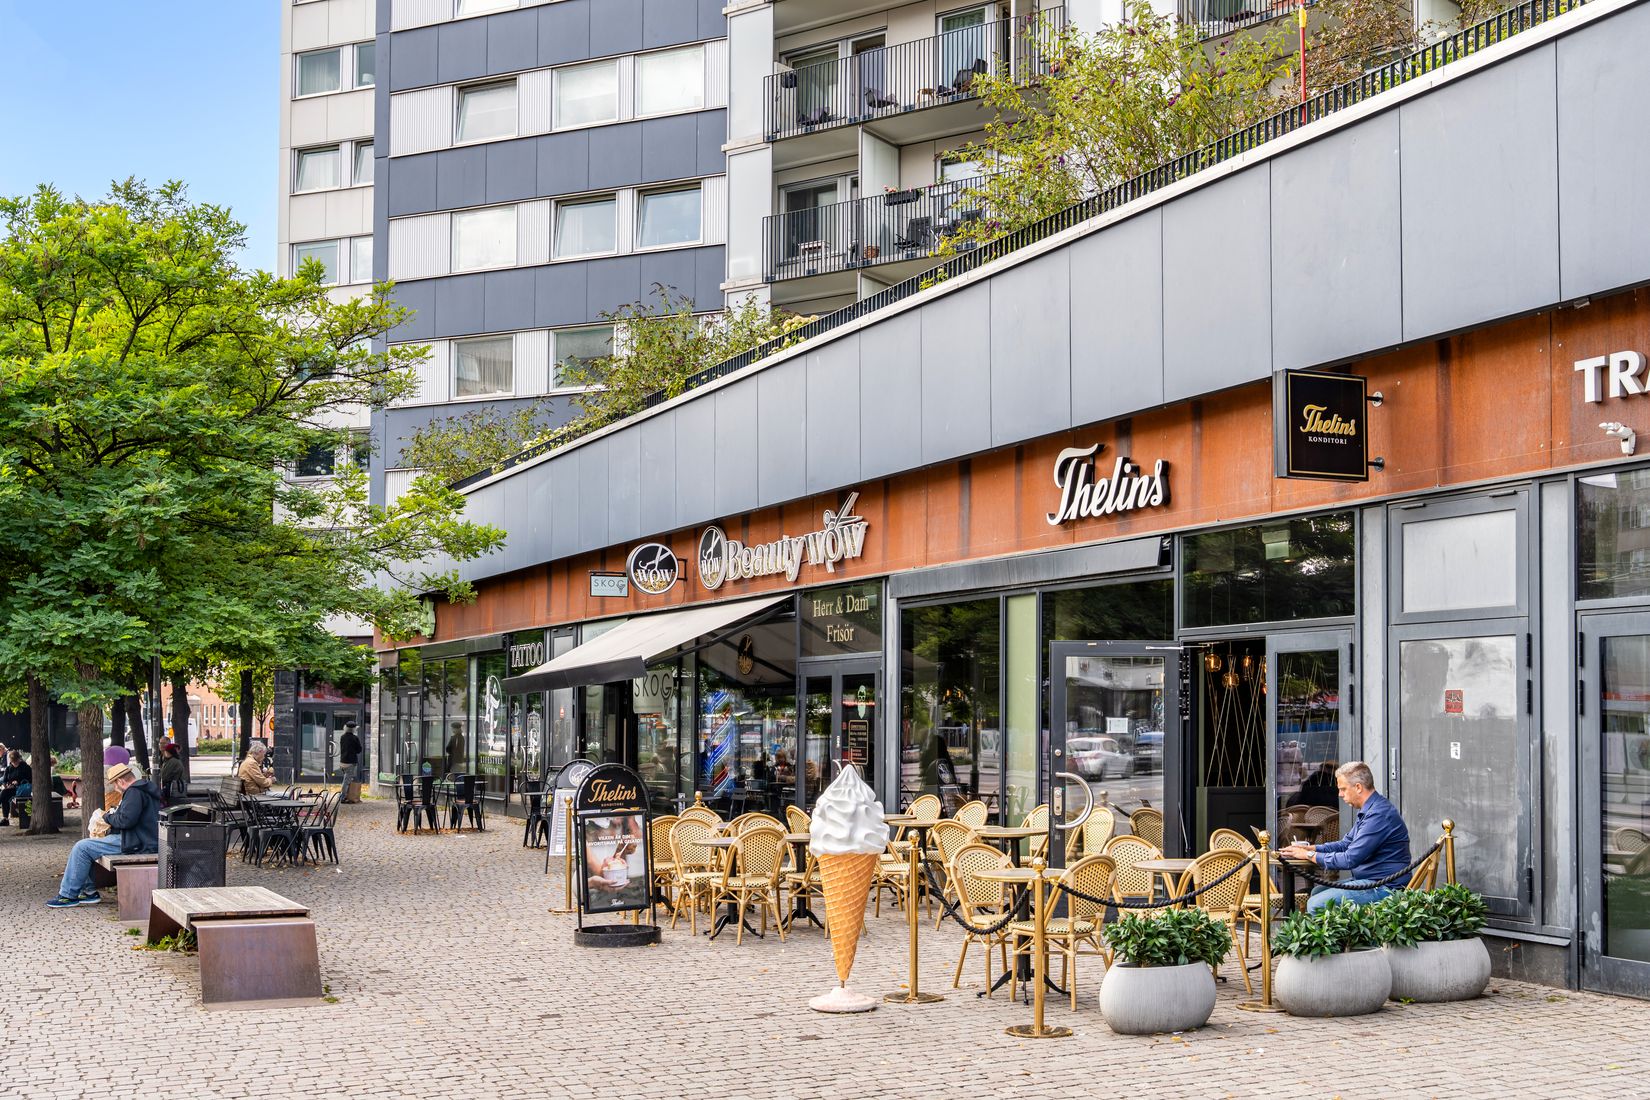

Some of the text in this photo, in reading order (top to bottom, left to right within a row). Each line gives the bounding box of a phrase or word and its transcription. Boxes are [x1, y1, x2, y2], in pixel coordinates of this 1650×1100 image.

[1574, 350, 1650, 403] TR
[1300, 404, 1356, 436] Thelins
[1308, 436, 1347, 445] KONDITORI
[1046, 443, 1169, 526] Thelins
[593, 579, 626, 589] SKOG
[813, 595, 869, 617] Herr & Dam
[826, 624, 854, 642] Frisör
[510, 642, 543, 667] TATTOO
[634, 673, 673, 700] SKOG
[588, 779, 637, 803] Thelins
